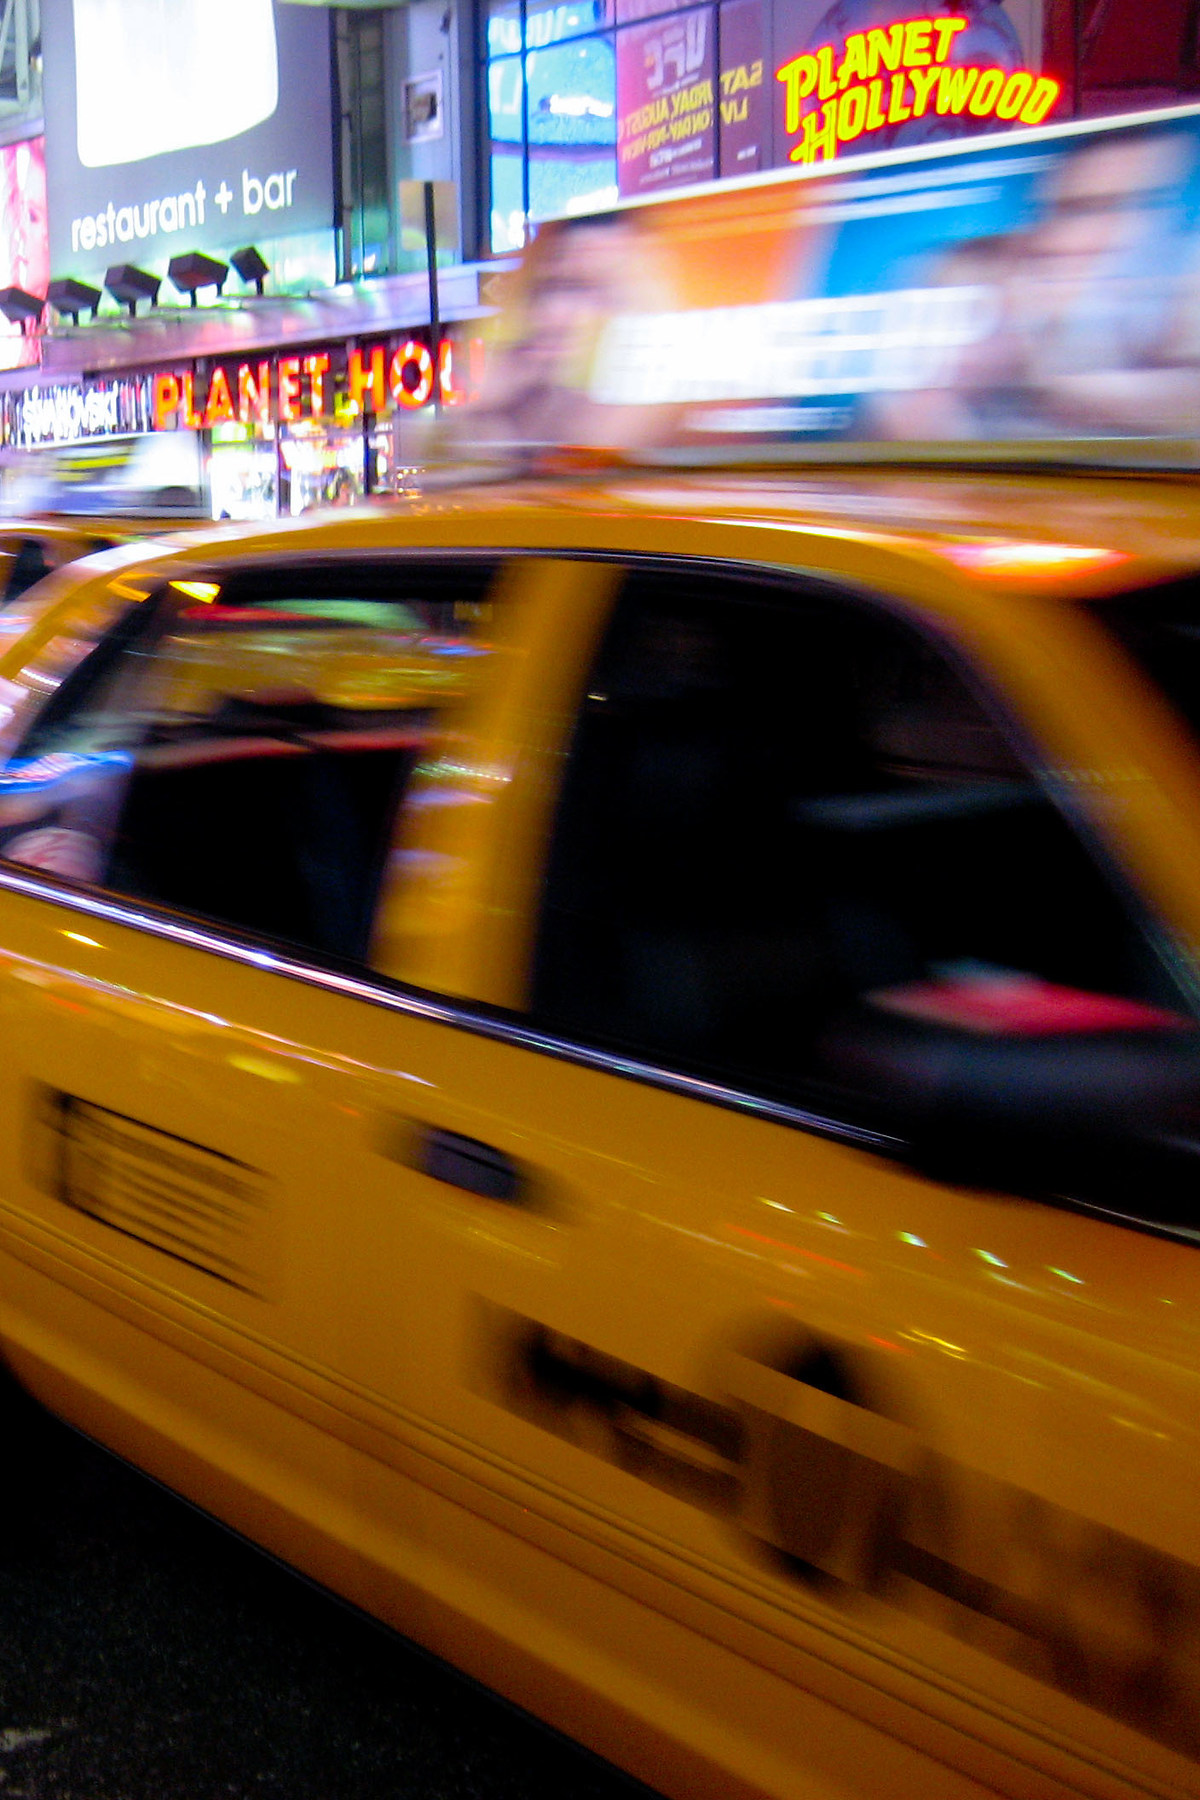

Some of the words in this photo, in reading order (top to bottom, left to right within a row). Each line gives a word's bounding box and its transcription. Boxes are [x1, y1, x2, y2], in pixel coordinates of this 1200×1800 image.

[776, 17, 967, 134] PLANET
[789, 66, 1059, 162] HOLLYWOOD
[71, 179, 206, 252] restaurant
[242, 168, 298, 215] bar
[153, 353, 330, 431] PLANET
